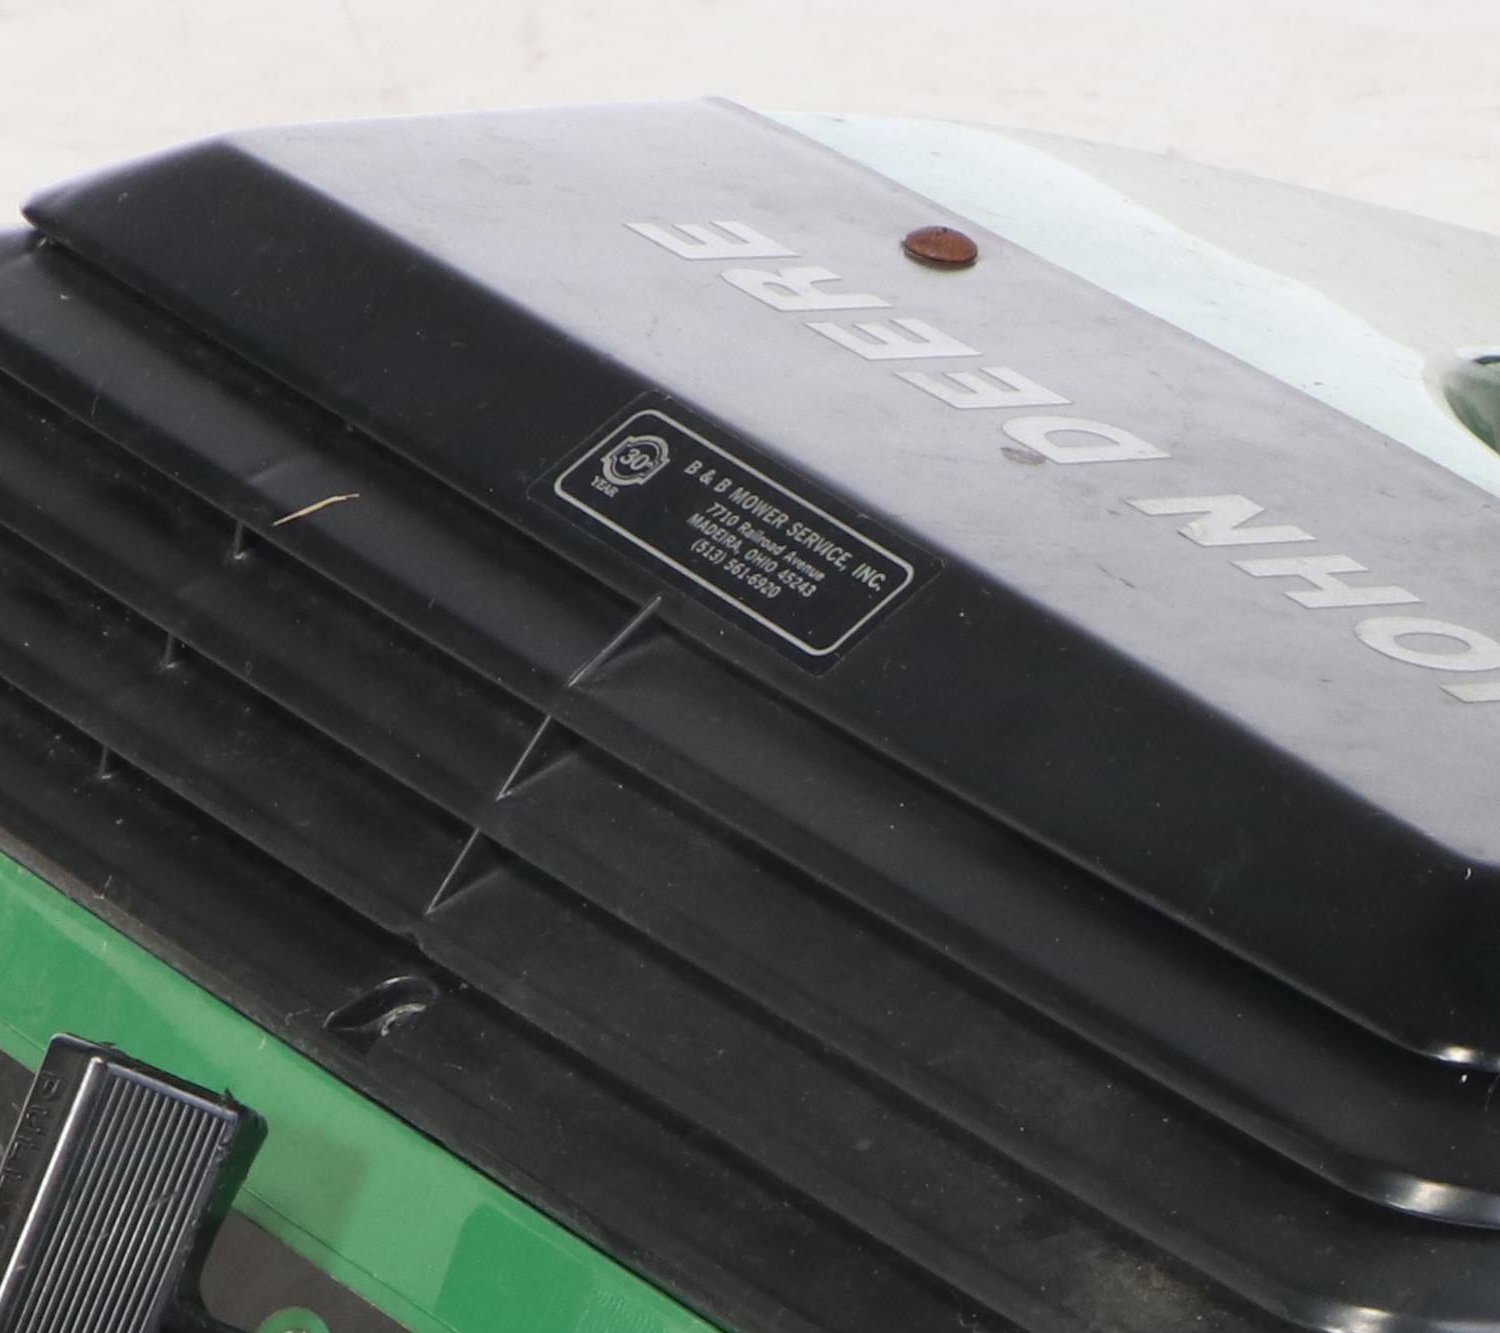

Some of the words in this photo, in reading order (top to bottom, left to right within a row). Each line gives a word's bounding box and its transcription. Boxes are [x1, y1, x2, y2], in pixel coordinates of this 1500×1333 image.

[623, 220, 1172, 464] DEERE
[590, 476, 620, 498] YEAR
[684, 460, 702, 476] B
[699, 469, 716, 485] &
[714, 478, 732, 494] B
[728, 487, 789, 529] MOWER
[786, 522, 853, 571] SERVICE,
[851, 563, 886, 592] INC.
[686, 513, 743, 555] MADEIRA,
[744, 548, 778, 573] OHIO
[777, 569, 817, 597] 45243
[690, 538, 726, 564] (513)
[723, 558, 781, 598] 561-6920
[706, 502, 739, 526] 7710
[737, 522, 787, 556] Railroad
[783, 551, 825, 581] Avenue
